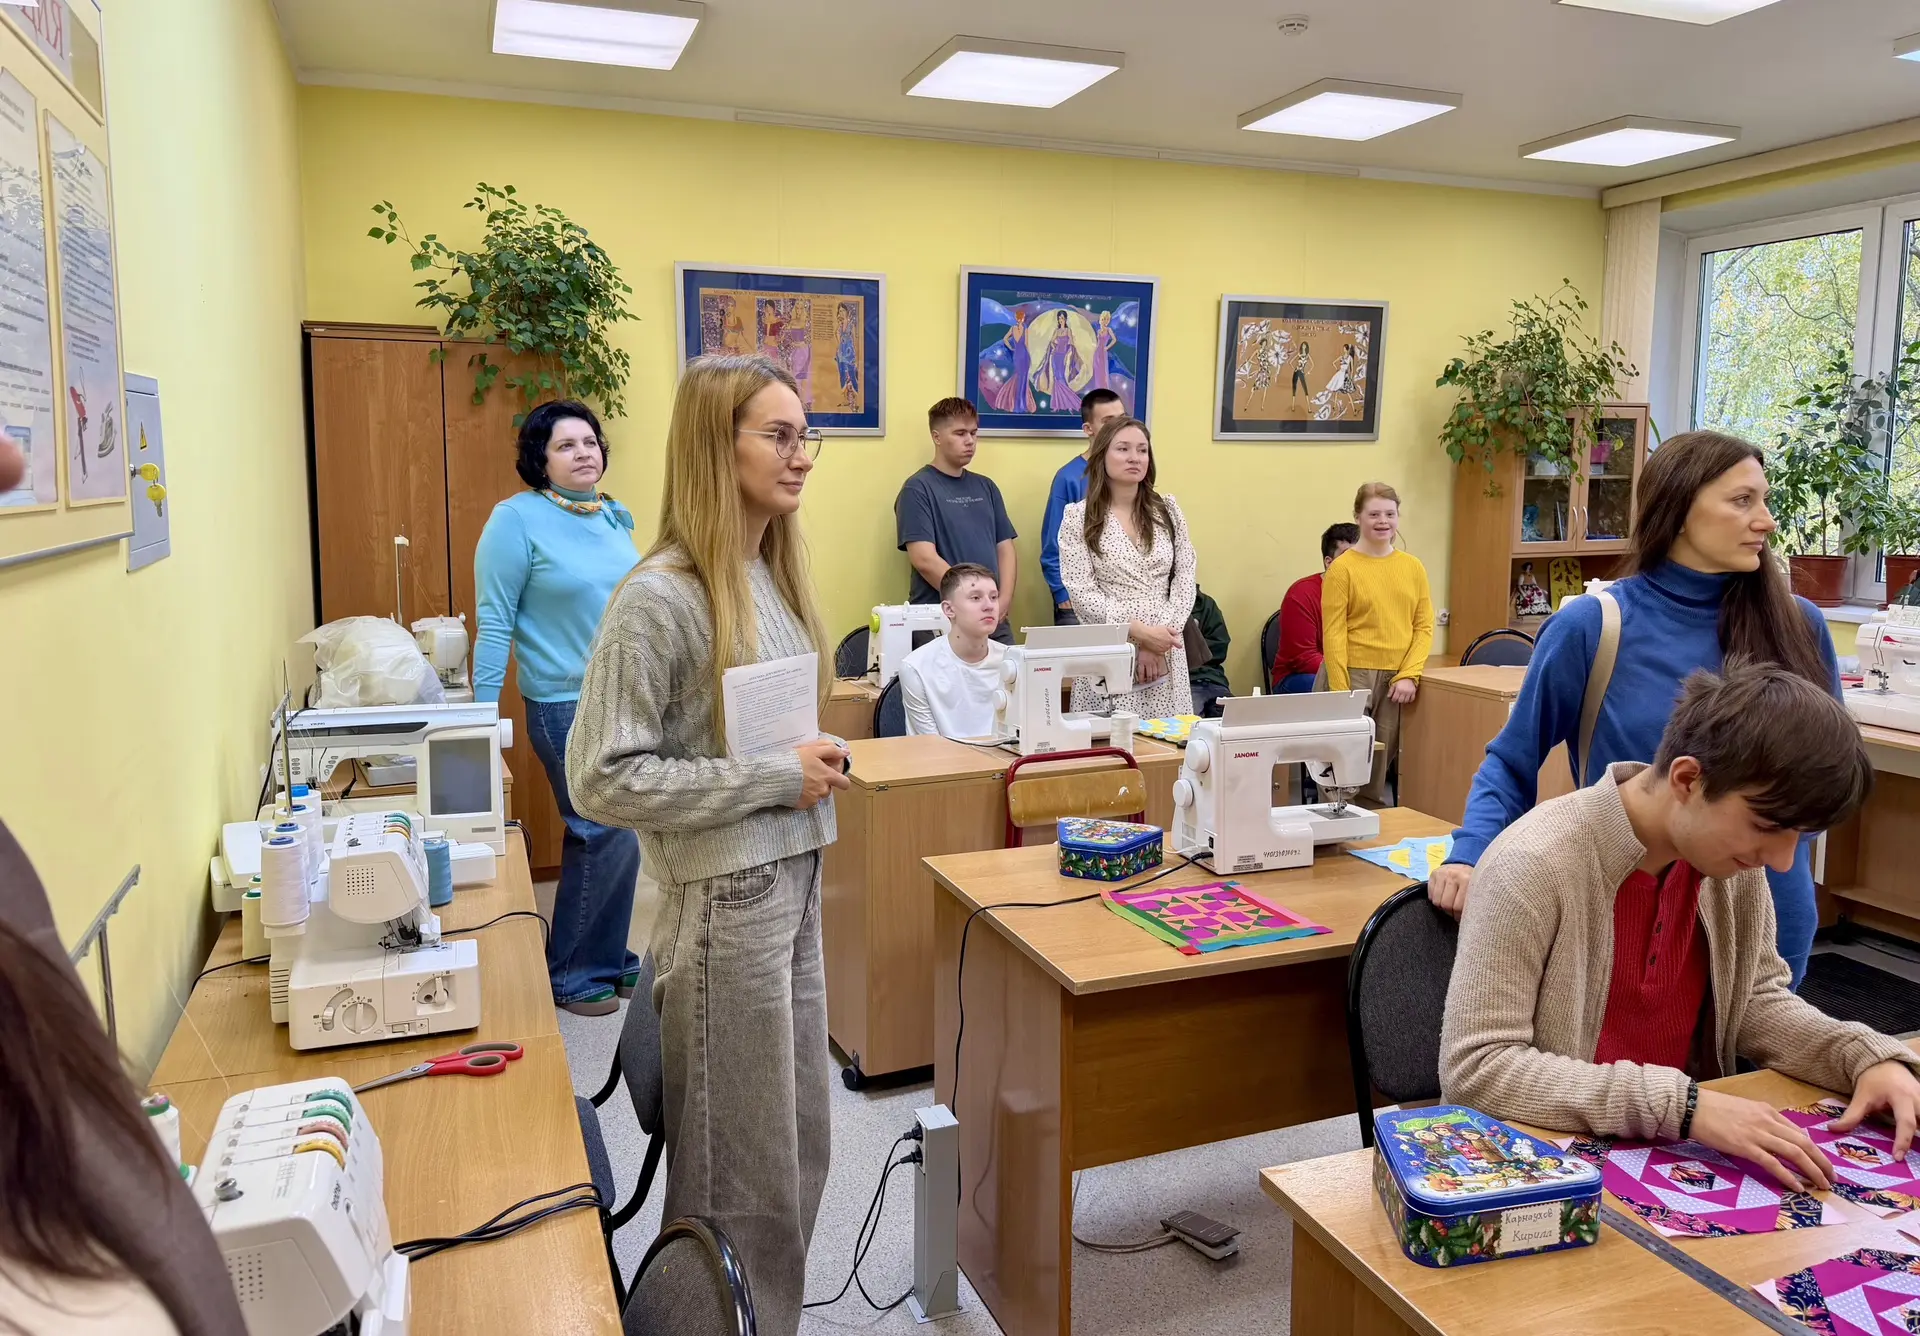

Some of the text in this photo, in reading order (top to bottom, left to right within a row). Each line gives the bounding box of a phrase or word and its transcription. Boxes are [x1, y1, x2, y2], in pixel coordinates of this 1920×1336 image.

[1233, 751, 1259, 759] JANOME
[1505, 1207, 1553, 1226] Карнаухов
[1512, 1230, 1553, 1243] Кирилл
